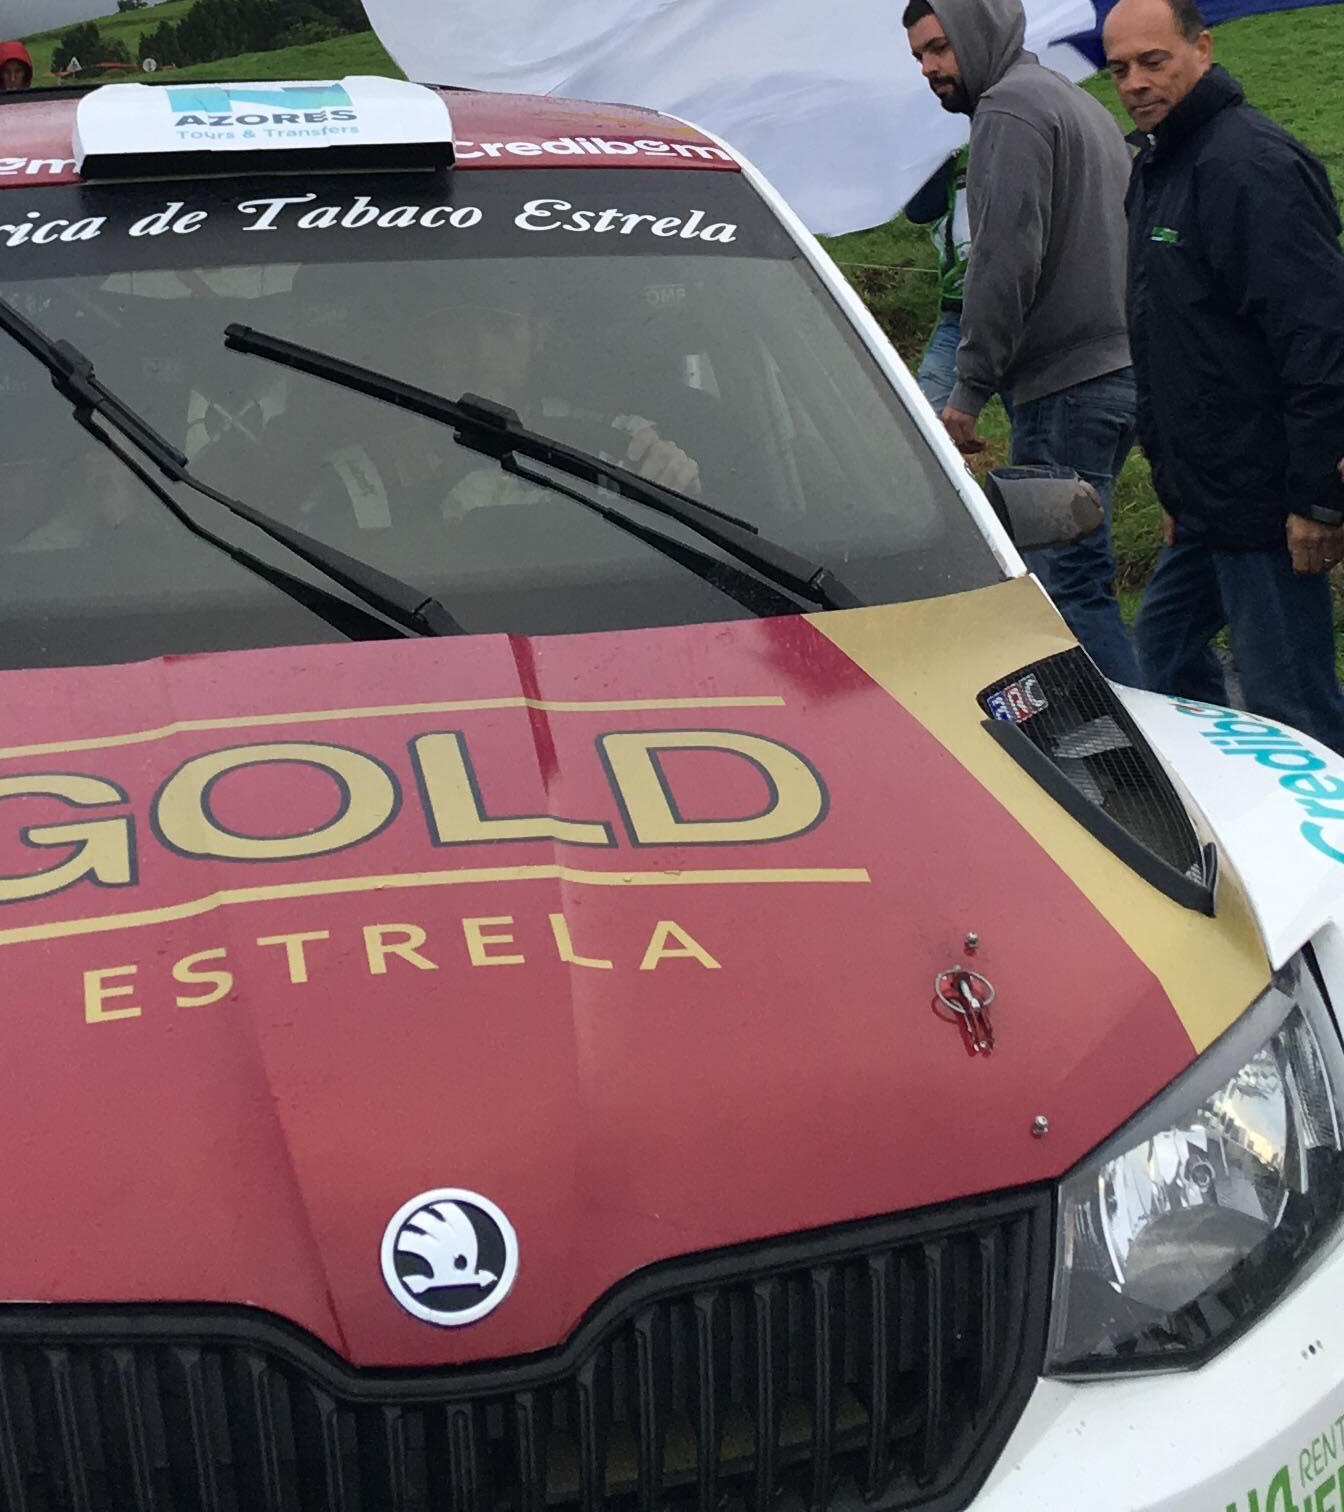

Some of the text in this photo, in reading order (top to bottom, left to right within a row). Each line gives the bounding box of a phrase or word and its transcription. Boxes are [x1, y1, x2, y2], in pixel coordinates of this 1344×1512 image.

[174, 109, 358, 127] AZORES
[177, 124, 360, 140] Tours & Transfers
[454, 137, 735, 161] Credibom
[128, 201, 208, 238] de
[237, 192, 483, 232] Tabaco
[514, 199, 738, 244] Estrela
[81, 911, 723, 1025] ESTRELA
